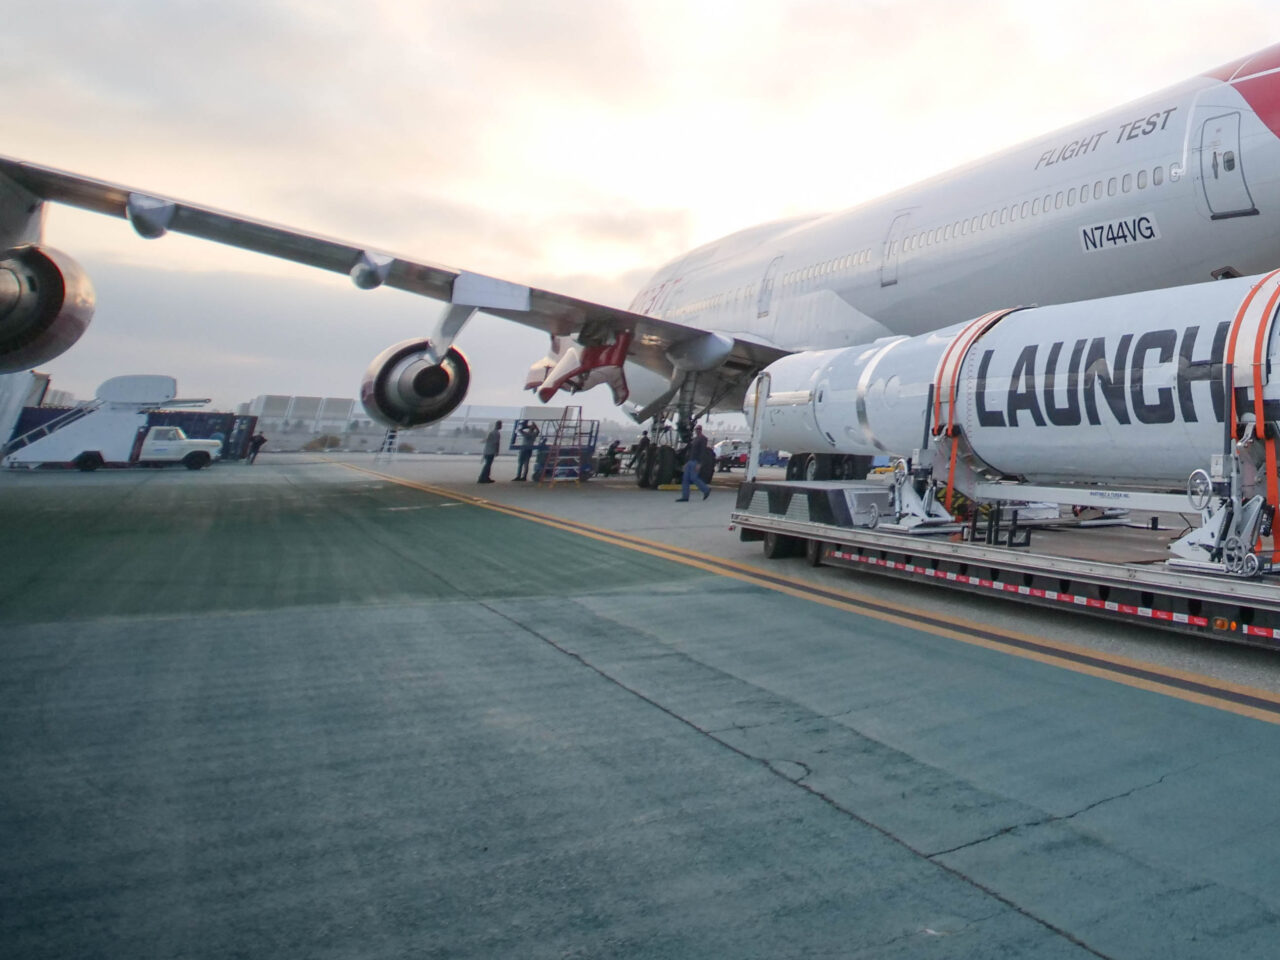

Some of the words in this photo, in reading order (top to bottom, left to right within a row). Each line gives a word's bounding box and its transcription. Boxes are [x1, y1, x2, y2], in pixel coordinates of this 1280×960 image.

[1034, 130, 1108, 171] FLIGHT
[1115, 106, 1178, 144] TEST
[1082, 216, 1156, 251] N744VG
